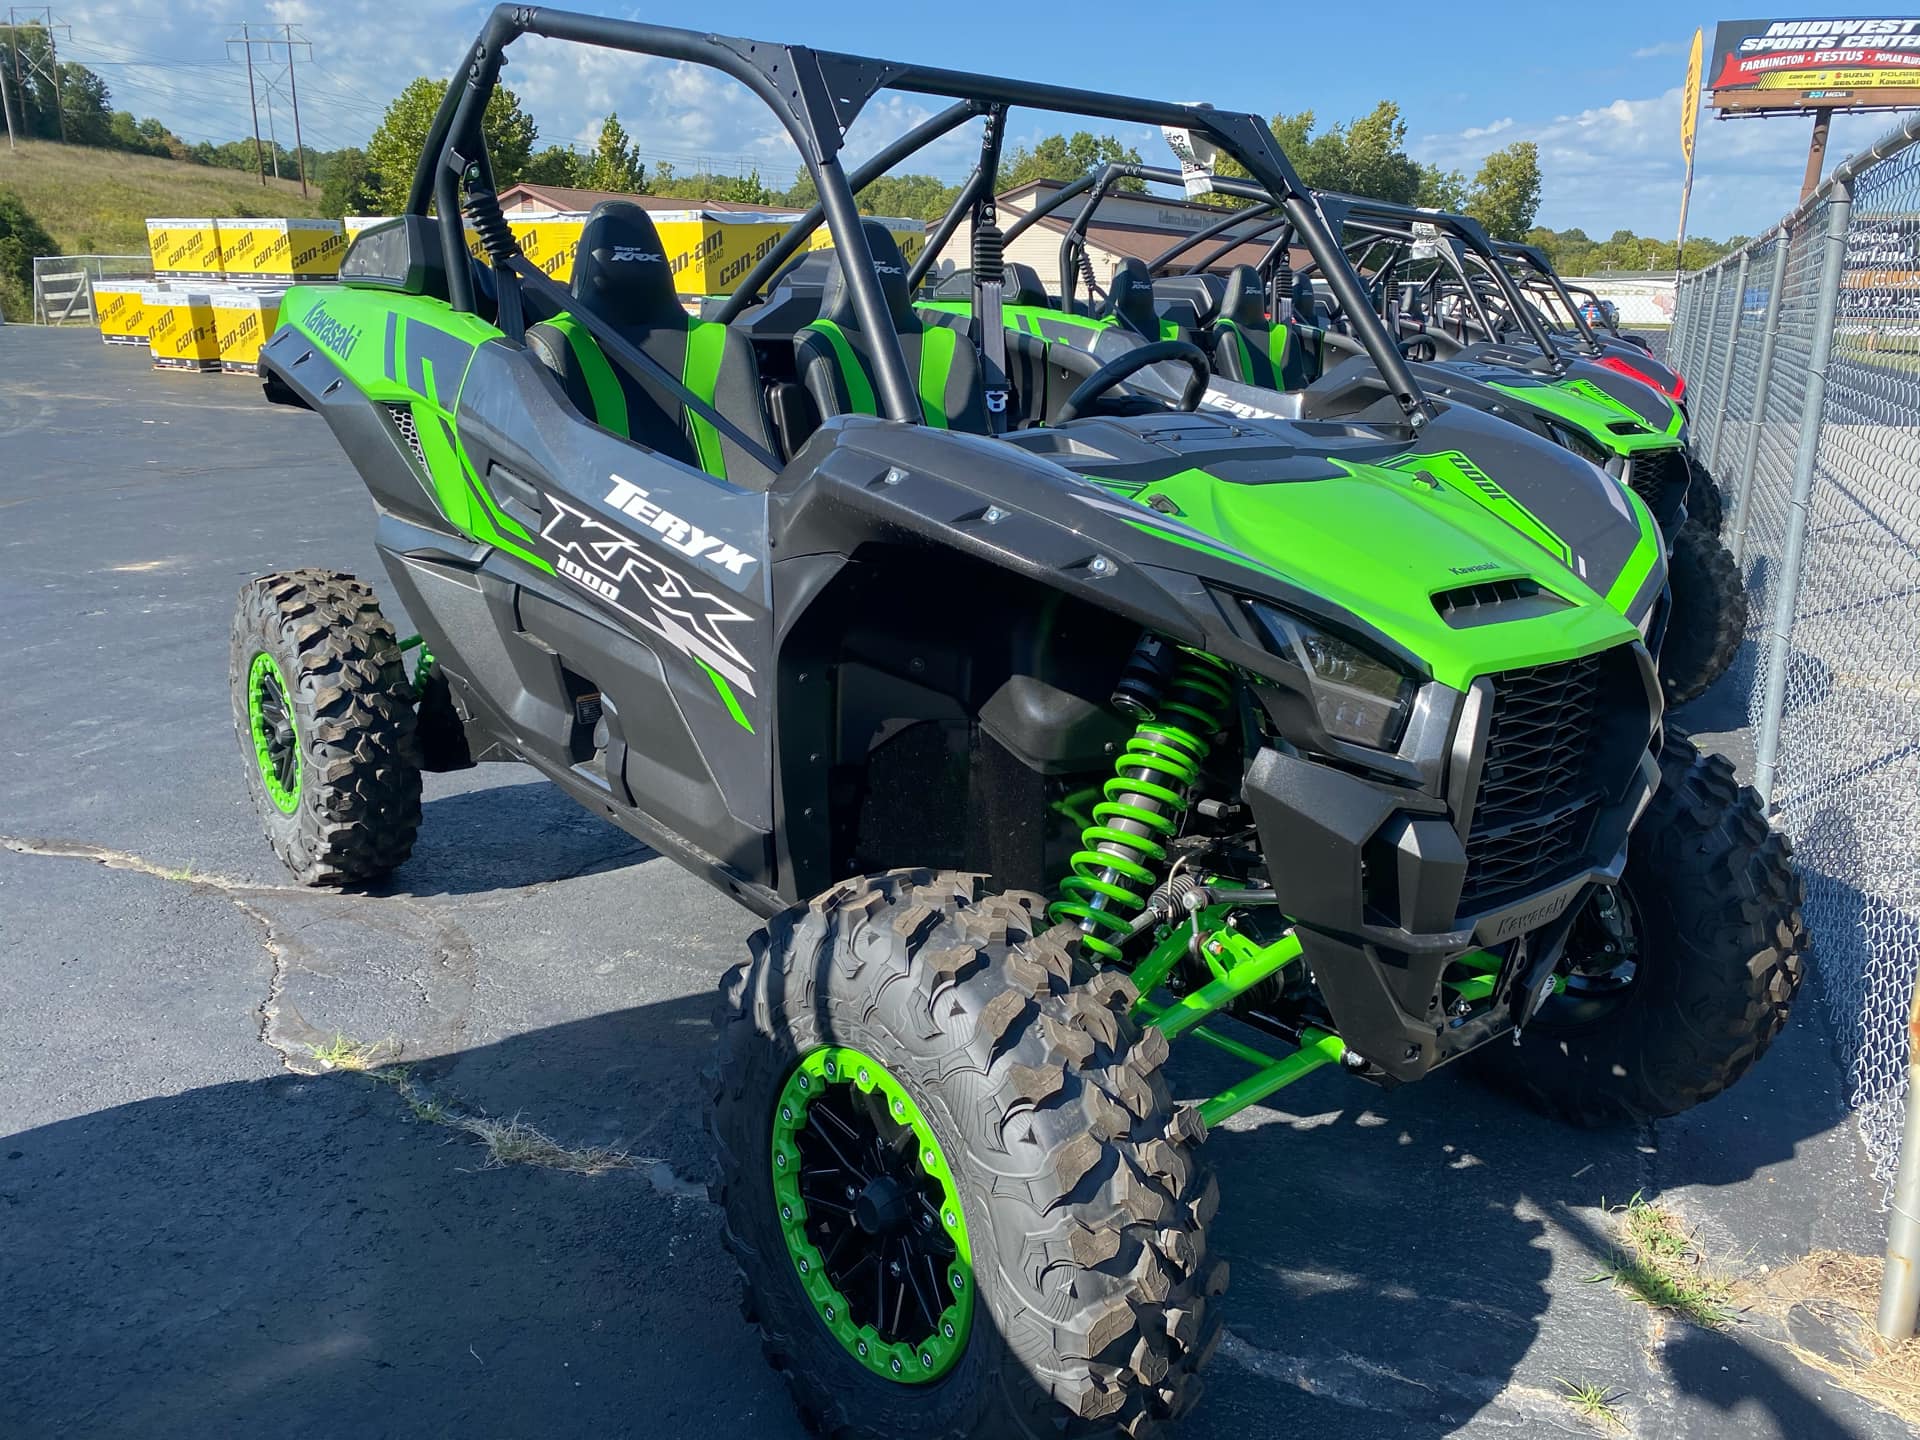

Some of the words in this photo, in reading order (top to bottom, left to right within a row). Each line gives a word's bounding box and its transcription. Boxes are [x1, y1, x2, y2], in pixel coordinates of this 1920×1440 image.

[1739, 36, 1837, 50] SPORTS
[1765, 19, 1920, 36] MIDWEST
[1739, 54, 1805, 71] FARMINGTON
[1814, 51, 1864, 62] FESTUS
[1874, 53, 1903, 63] POPLAR
[1903, 55, 1920, 65] BLUF
[168, 231, 203, 267] can-am
[223, 231, 254, 264] an-am
[253, 231, 291, 269] can-am
[291, 234, 342, 270] can-am
[611, 251, 662, 262] KRX
[670, 229, 723, 275] an-am
[98, 295, 125, 325] an-am
[125, 310, 145, 332] can-
[302, 298, 362, 362] Kawasaki
[603, 473, 758, 575] TERYX
[540, 492, 757, 673] KRX
[555, 553, 620, 602] 1000
[1448, 562, 1500, 575] Kawasaki
